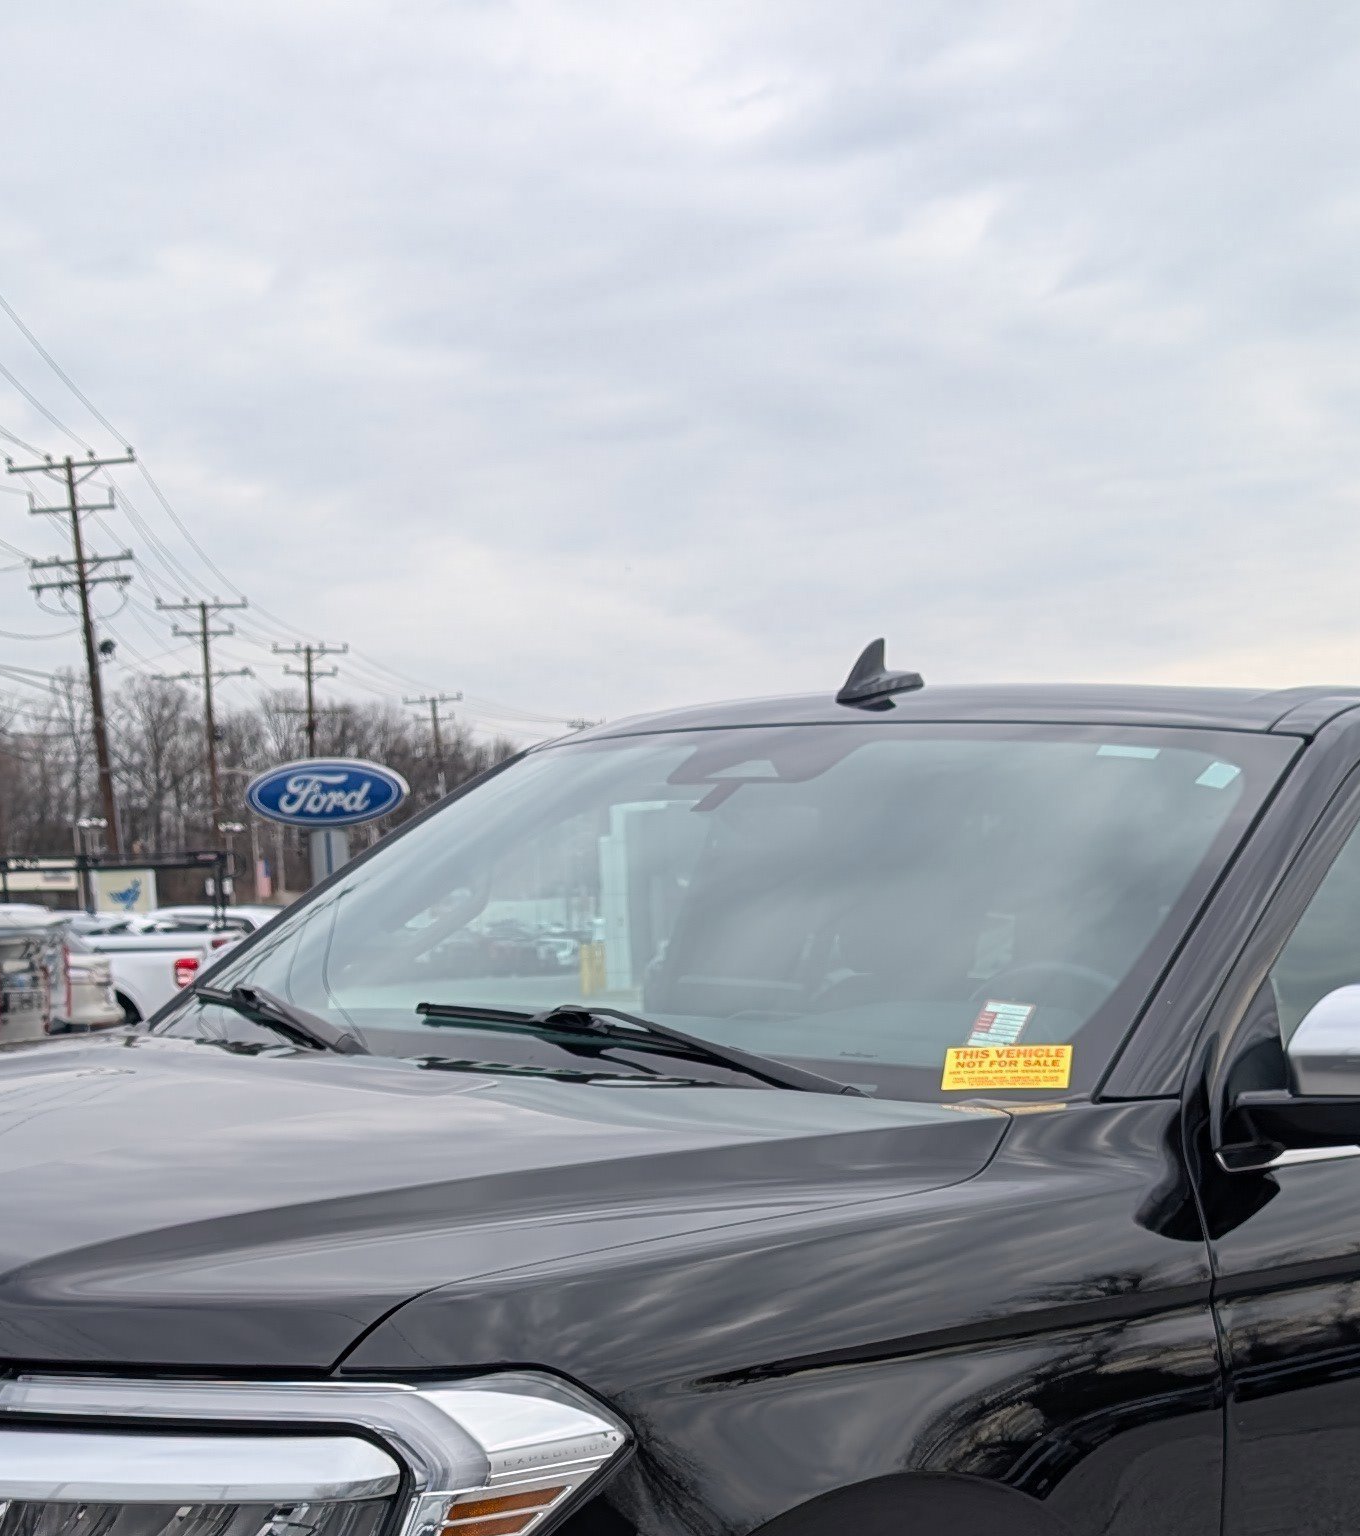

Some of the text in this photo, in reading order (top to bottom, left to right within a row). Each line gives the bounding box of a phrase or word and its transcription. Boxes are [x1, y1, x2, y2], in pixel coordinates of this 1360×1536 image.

[278, 773, 372, 815] Ford
[954, 1048, 1066, 1060] THIS VEHICLE
[955, 1059, 1061, 1069] NOT FOR SALE
[503, 1441, 610, 1468] EXPEDITION
